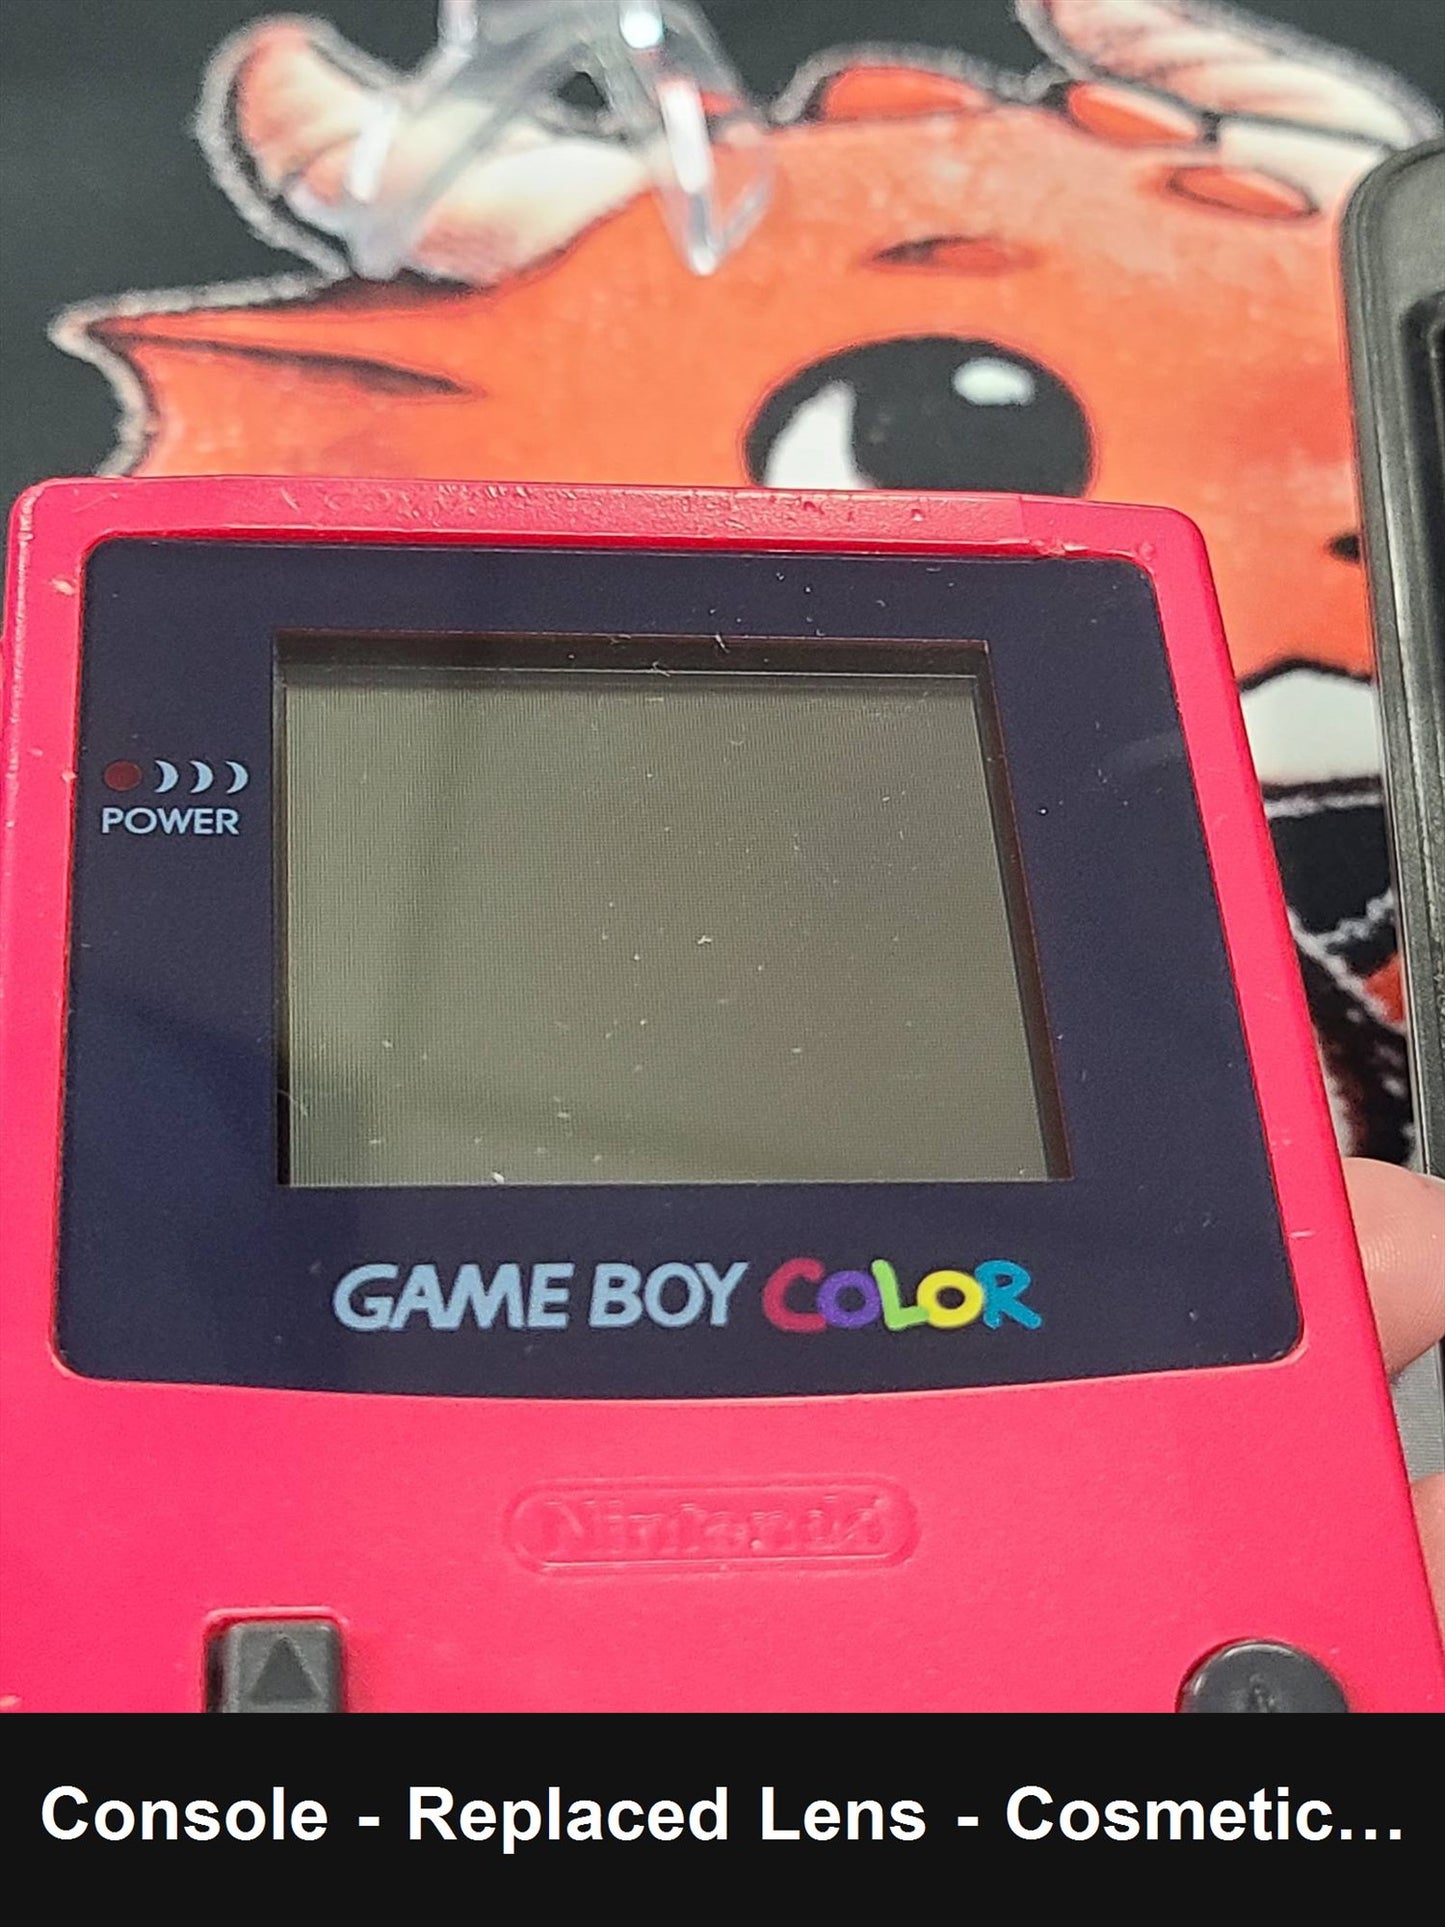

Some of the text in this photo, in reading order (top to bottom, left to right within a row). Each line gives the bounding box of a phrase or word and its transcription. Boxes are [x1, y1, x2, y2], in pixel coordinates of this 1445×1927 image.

[102, 806, 240, 835] POWER
[333, 1258, 1042, 1333] GAME BOY COLOR
[540, 1493, 892, 1555] Nintendo
